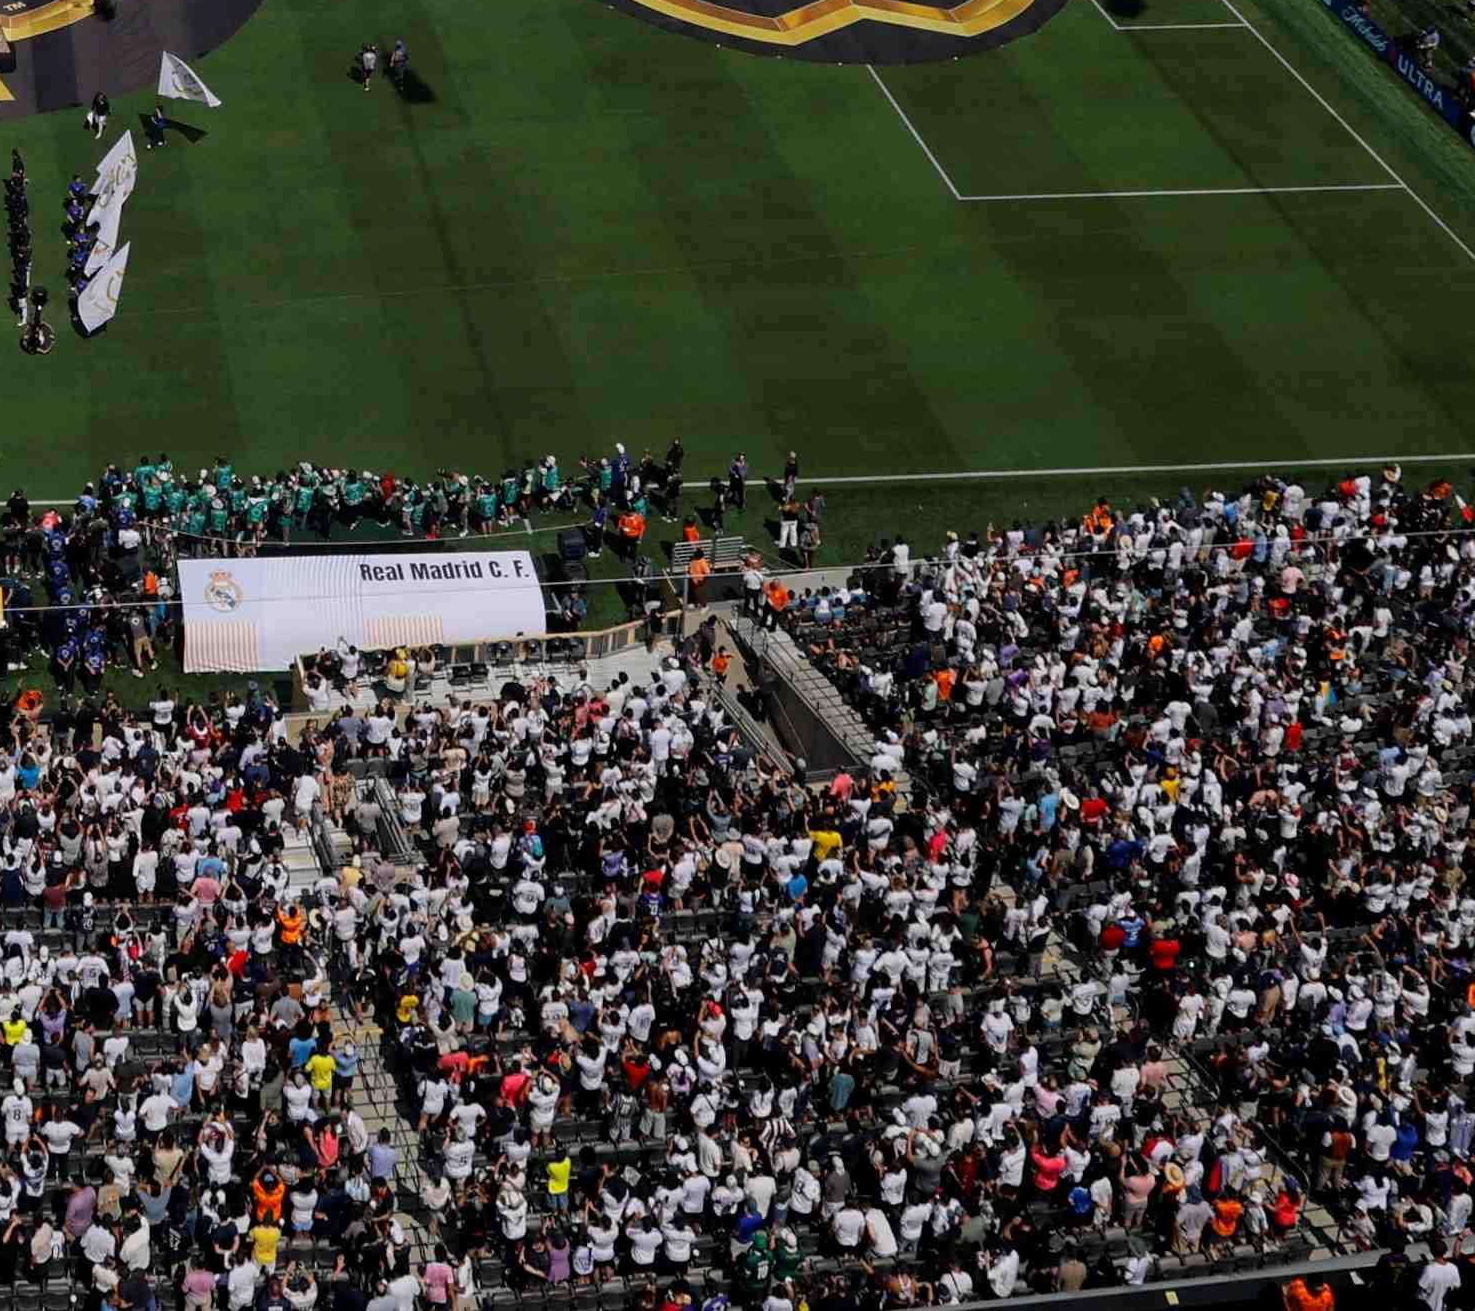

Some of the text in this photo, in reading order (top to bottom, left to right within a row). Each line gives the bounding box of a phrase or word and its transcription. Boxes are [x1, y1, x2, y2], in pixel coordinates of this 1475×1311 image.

[1396, 53, 1446, 111] ULTRA
[359, 560, 531, 582] Real Madrid C. F.
